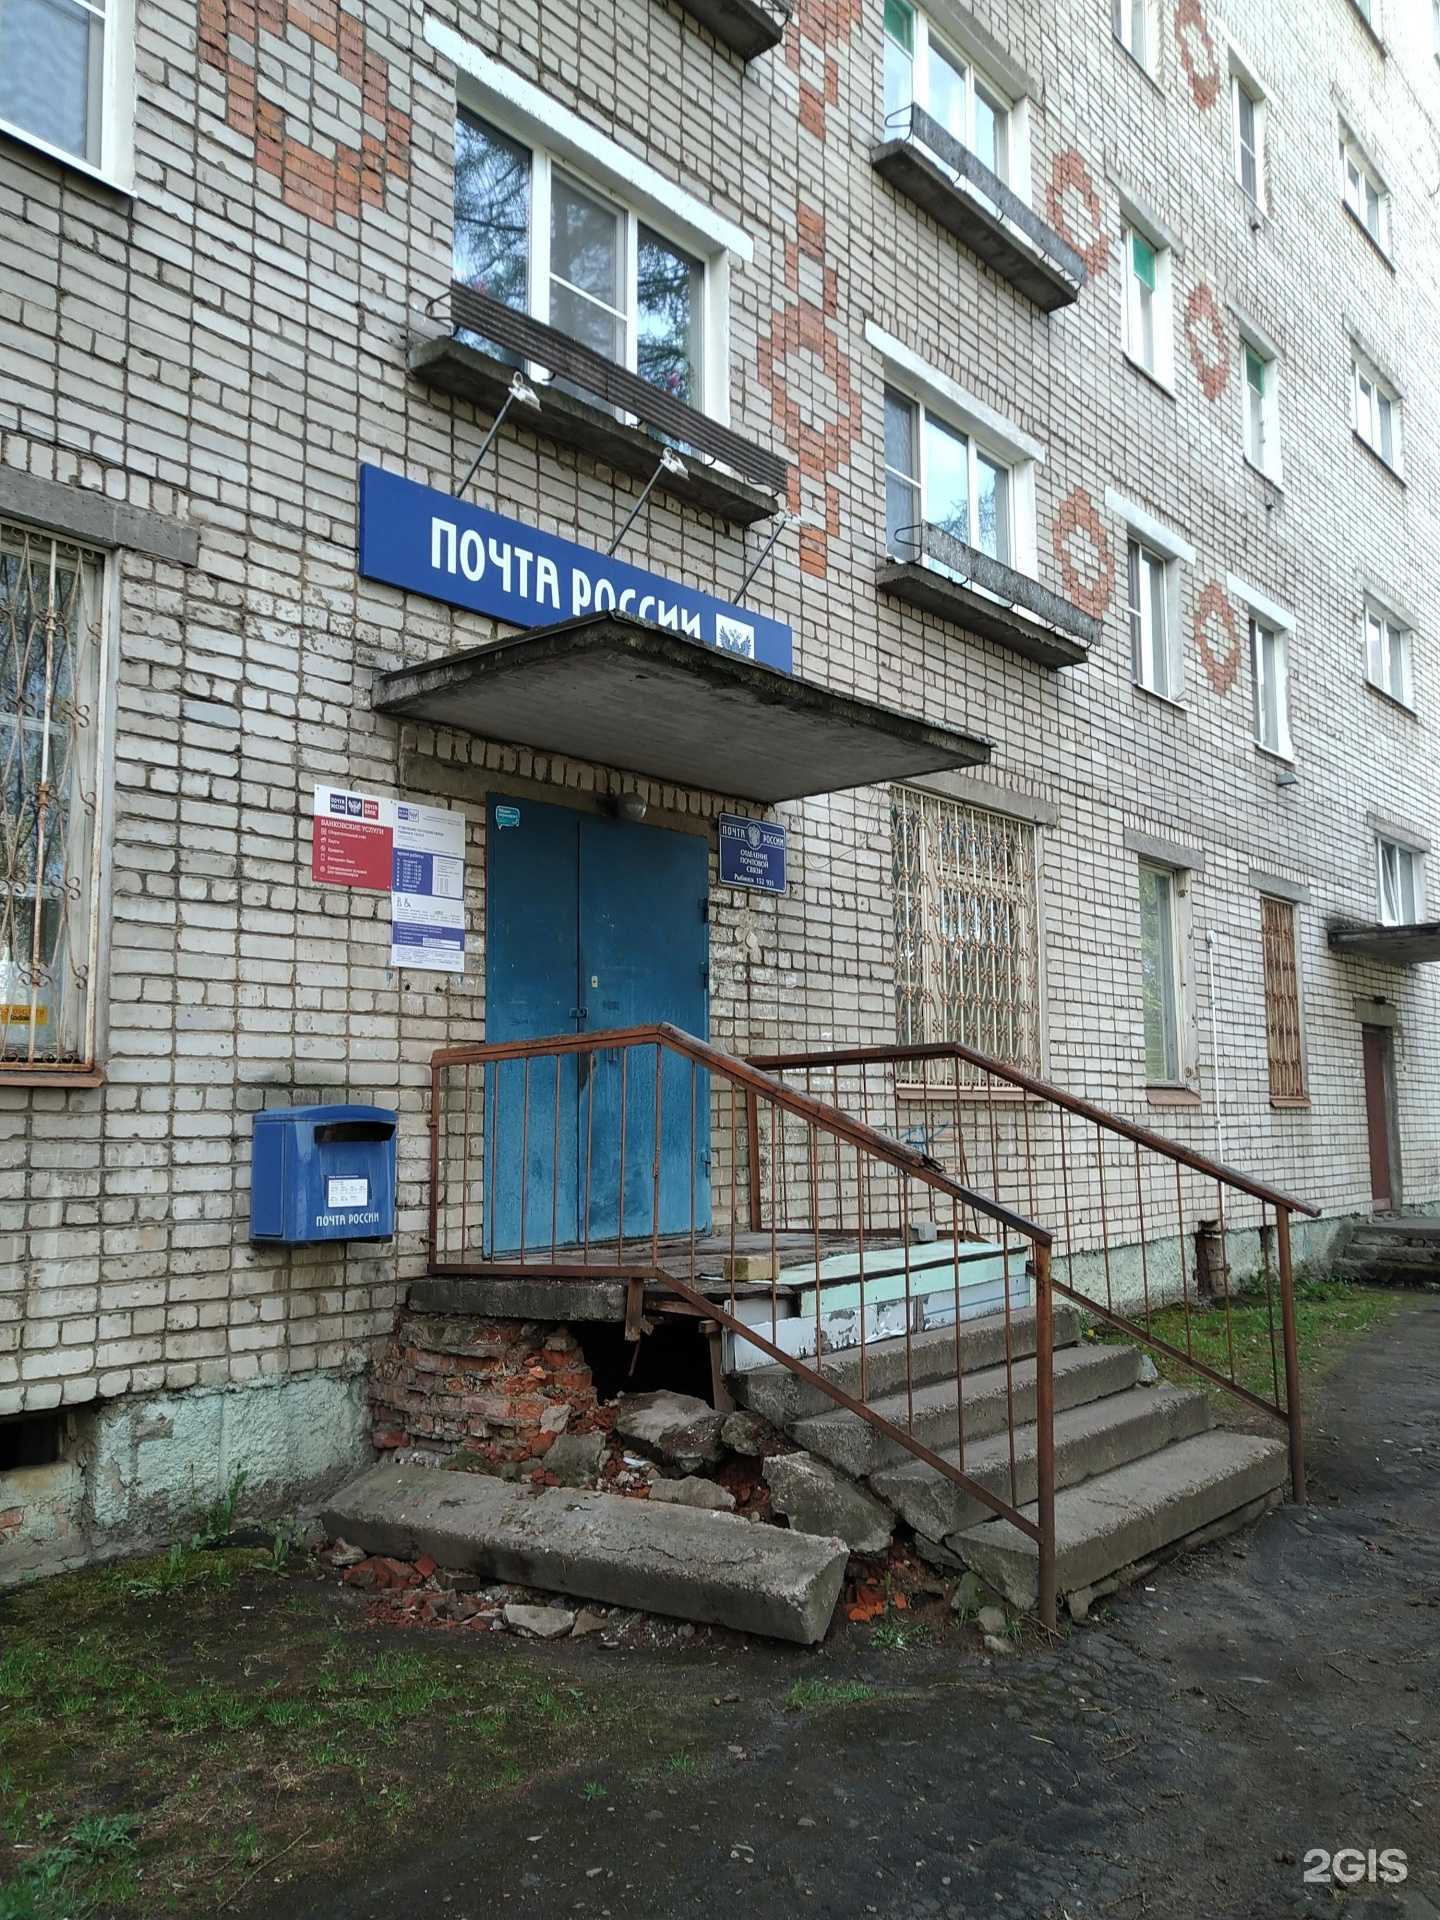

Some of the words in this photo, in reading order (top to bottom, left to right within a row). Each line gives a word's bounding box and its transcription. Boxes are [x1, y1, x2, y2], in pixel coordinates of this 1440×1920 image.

[431, 516, 561, 610] ПОЧТА
[320, 820, 361, 831] БАНКОВСКИЕ
[362, 825, 384, 835] УСЛУГИ
[722, 825, 746, 839] ПОЧТА
[763, 834, 784, 848] РОССИИ
[739, 857, 769, 869] ПОЧТОВОЙ
[746, 866, 763, 875] СВЯЗИ
[316, 1215, 346, 1227] ПОЧТА
[348, 1212, 379, 1225] РОССИИ
